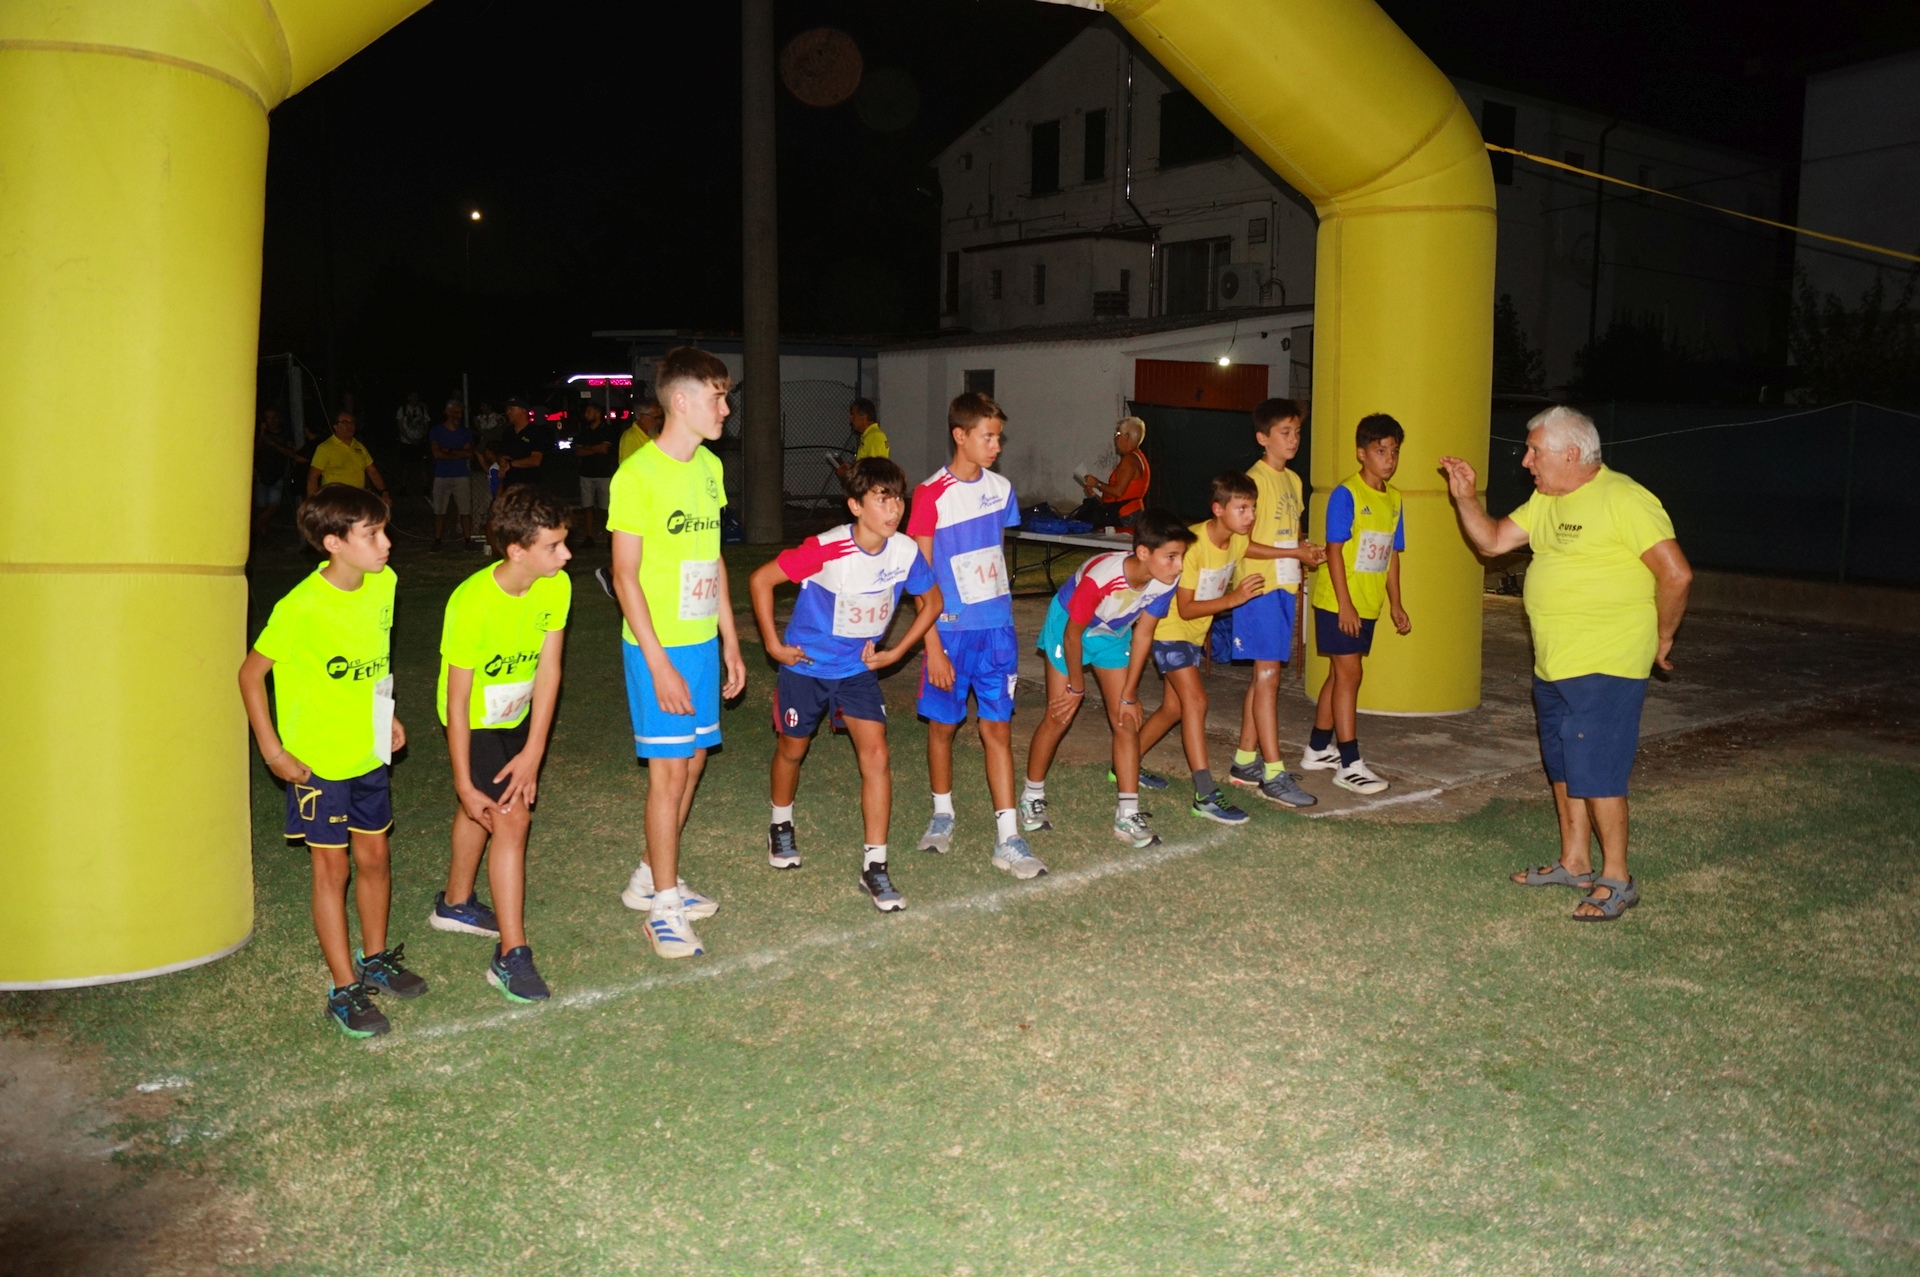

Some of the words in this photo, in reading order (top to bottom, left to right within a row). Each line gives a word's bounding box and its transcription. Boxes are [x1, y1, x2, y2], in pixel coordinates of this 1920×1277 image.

[975, 562, 998, 584] 14
[692, 576, 718, 600] 476
[848, 602, 889, 624] 318
[500, 693, 532, 718] 47
